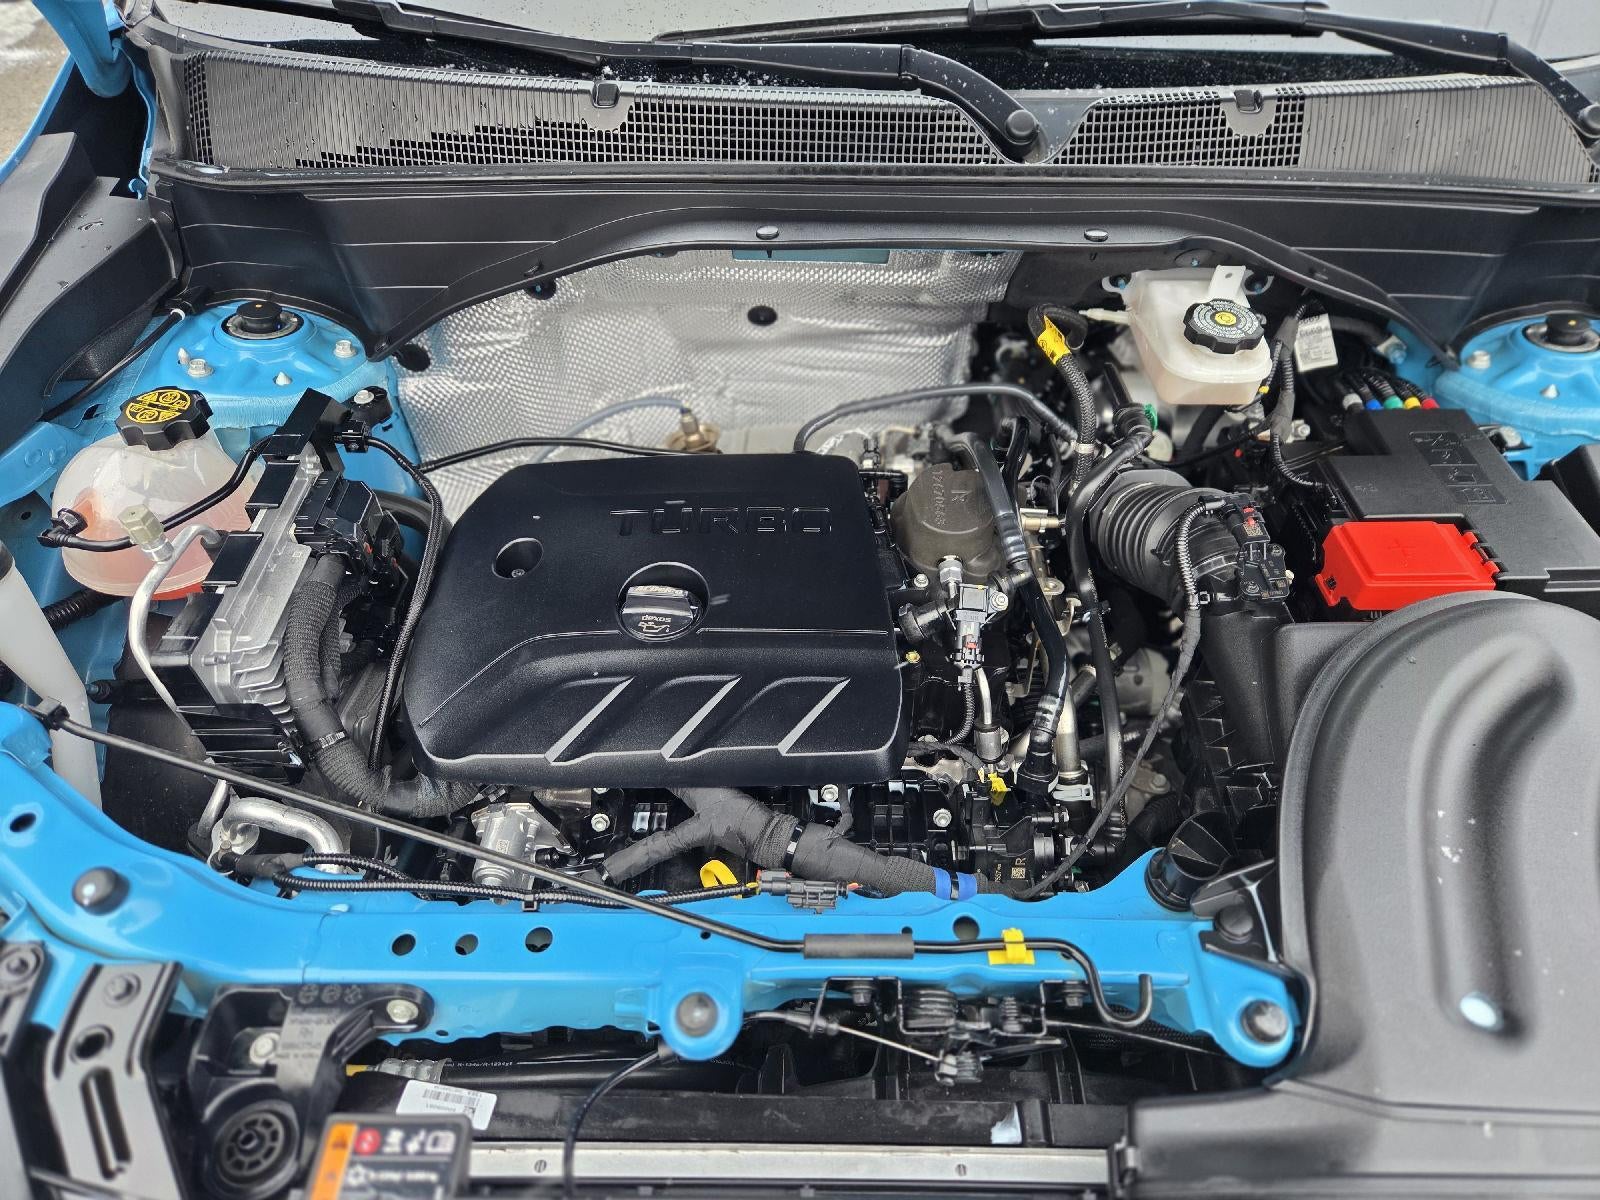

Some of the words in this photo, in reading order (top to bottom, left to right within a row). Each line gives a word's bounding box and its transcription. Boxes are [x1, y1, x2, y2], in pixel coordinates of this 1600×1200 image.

[610, 506, 832, 537] TURBO
[641, 614, 672, 623] dexos
[1015, 857, 1027, 866] R
